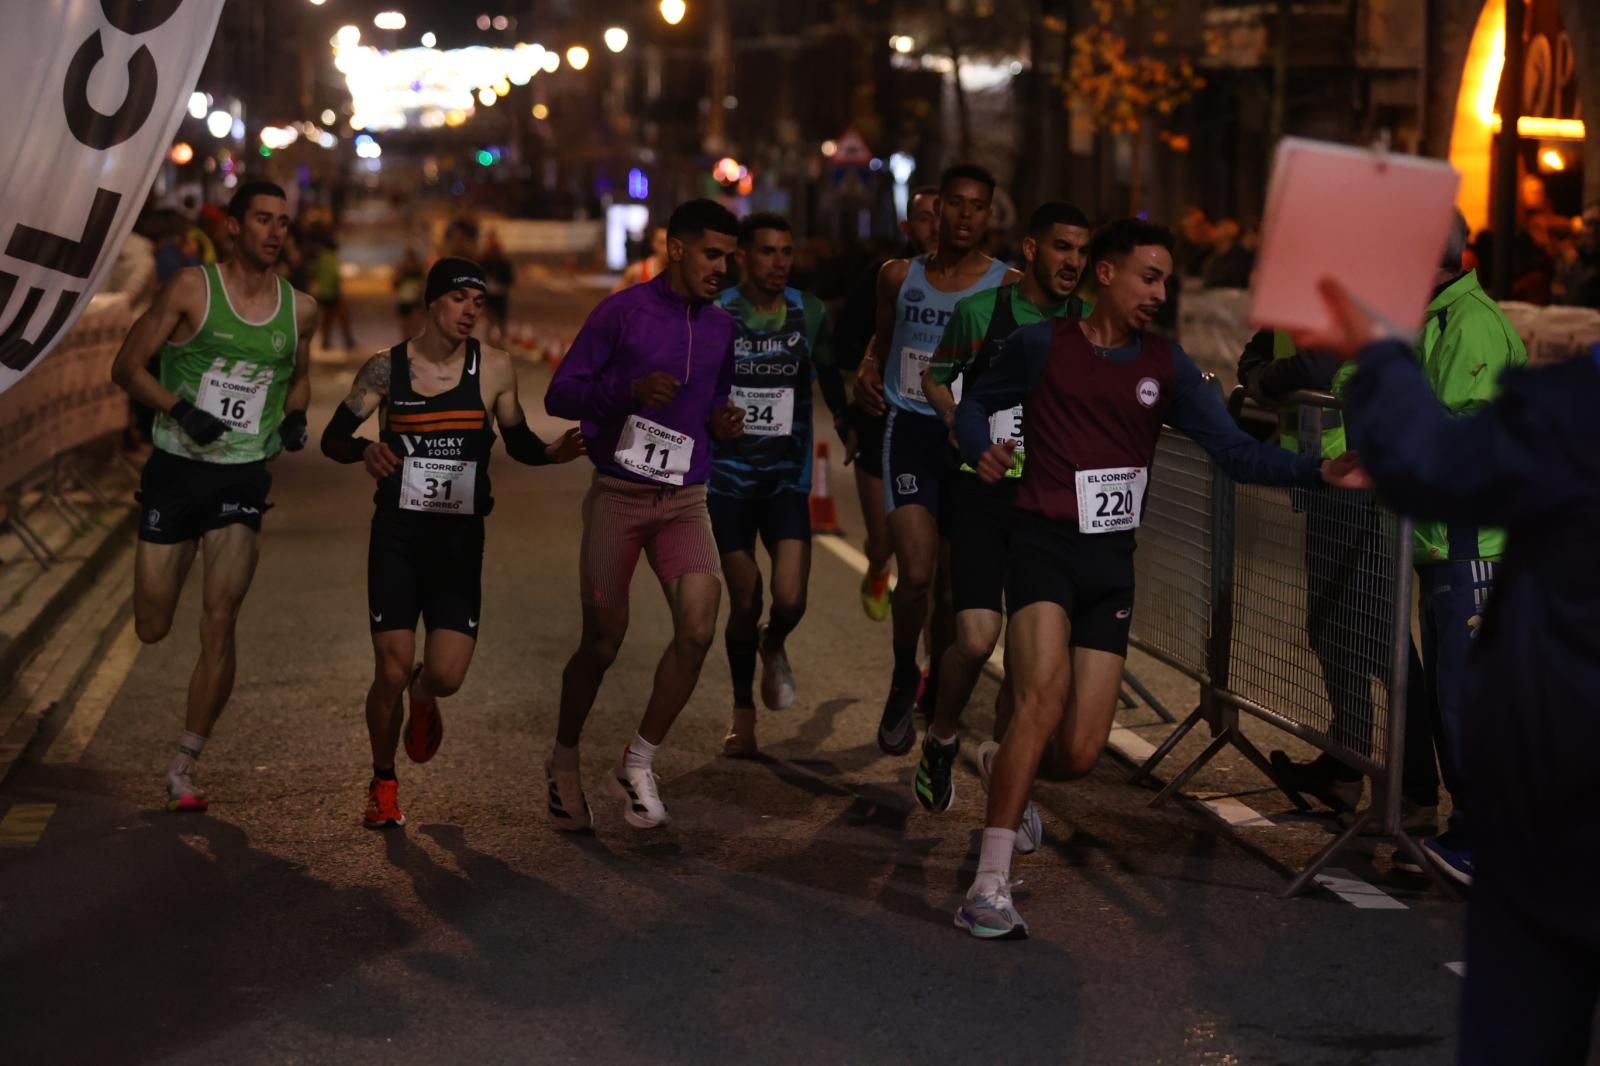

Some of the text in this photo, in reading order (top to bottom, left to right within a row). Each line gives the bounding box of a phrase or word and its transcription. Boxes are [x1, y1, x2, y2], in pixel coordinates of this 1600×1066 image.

[63, 0, 184, 150] C
[210, 379, 220, 387] EL
[222, 382, 257, 394] CORREO
[220, 397, 246, 419] 16
[745, 405, 773, 424] 34
[635, 421, 647, 431] EL
[648, 426, 683, 445] CORREO
[425, 437, 464, 448] VICKY
[428, 448, 462, 456] FOODS
[644, 443, 670, 469] 11
[413, 461, 464, 472] EL CORREO
[1087, 472, 1137, 483] EL CORREO
[423, 477, 452, 500] 31
[422, 500, 460, 509] CORREO
[1095, 489, 1132, 517] 220
[1104, 516, 1133, 527] CORREO
